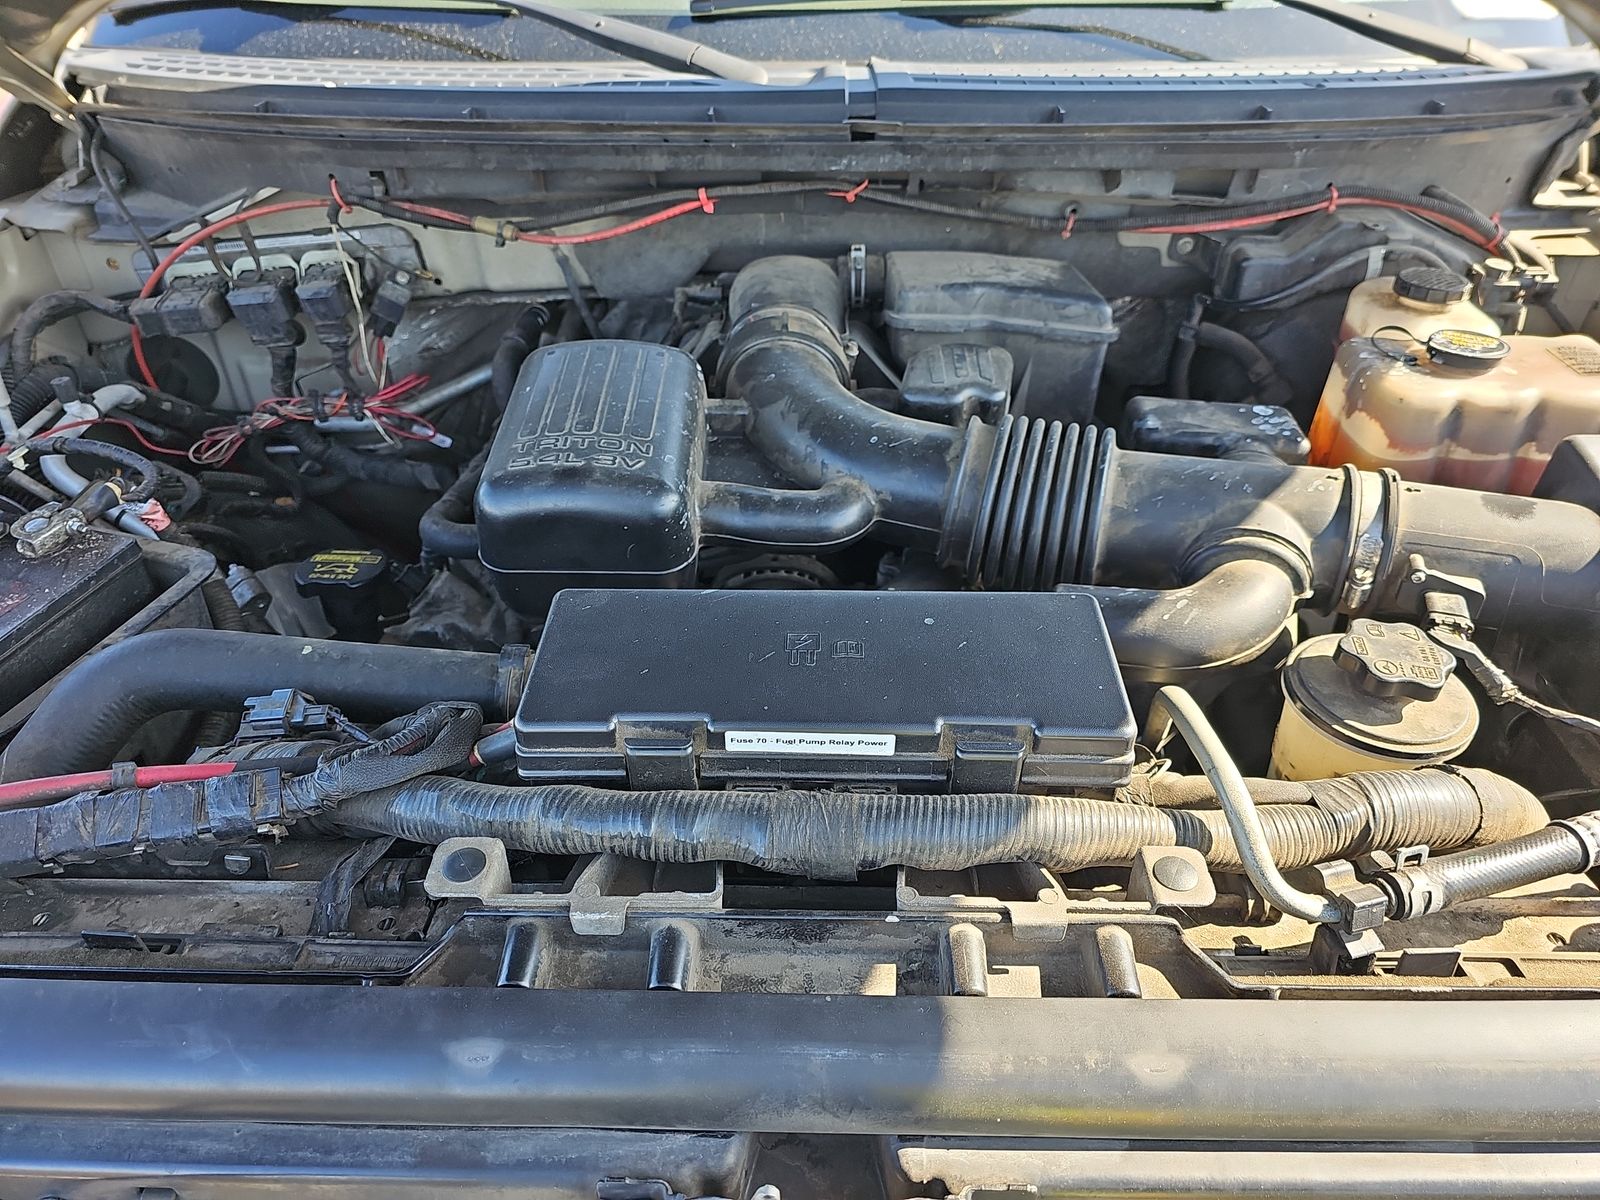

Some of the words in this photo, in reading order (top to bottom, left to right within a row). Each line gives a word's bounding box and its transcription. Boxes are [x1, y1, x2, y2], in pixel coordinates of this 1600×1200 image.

[512, 435, 654, 457] TRITON
[592, 453, 646, 470] 3V
[799, 738, 826, 746] Pump
[829, 739, 855, 747] Relay
